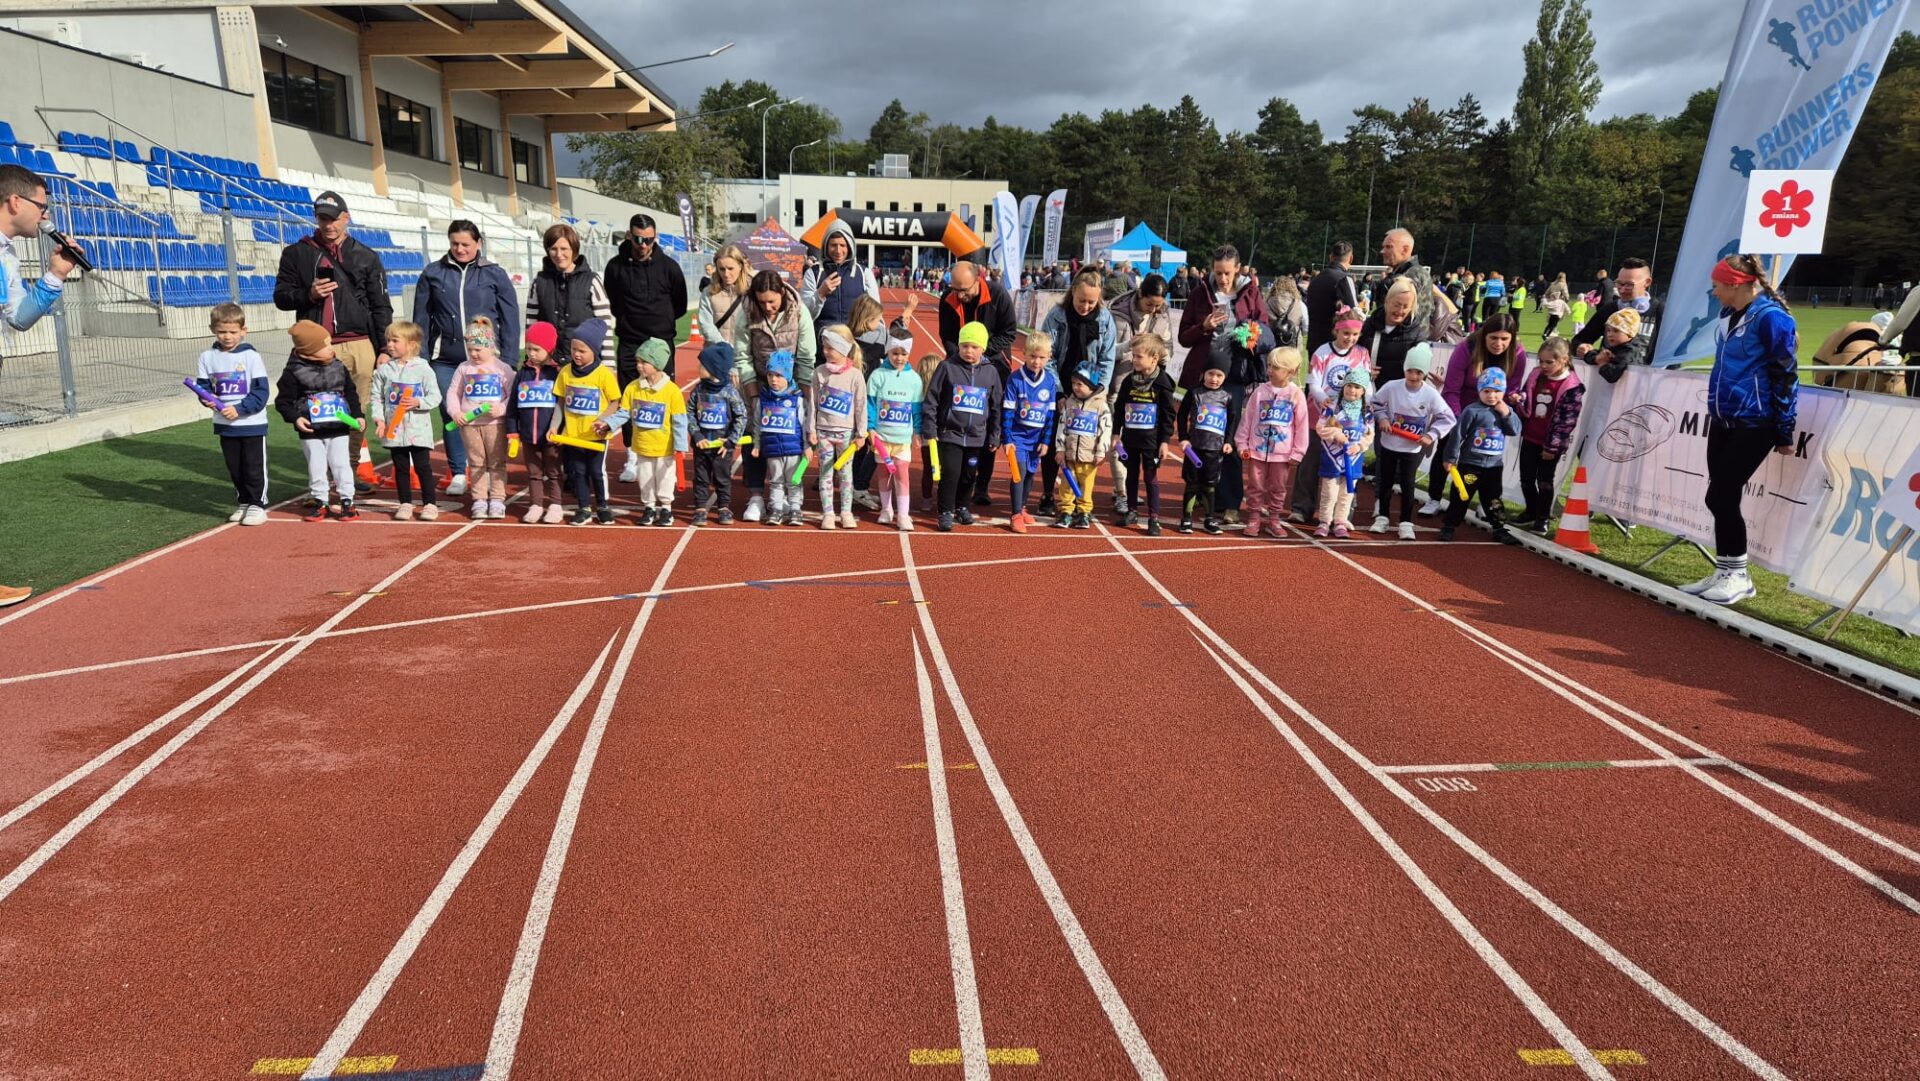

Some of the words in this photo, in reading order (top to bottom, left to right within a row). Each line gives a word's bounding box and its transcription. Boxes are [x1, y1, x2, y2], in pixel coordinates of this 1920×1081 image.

[1796, 0, 1845, 34] RU
[1755, 62, 1875, 160] RUNNER'S
[1781, 195, 1793, 211] 1
[861, 216, 925, 236] META
[220, 382, 240, 394] 1/2
[474, 383, 498, 395] 35/1
[528, 389, 553, 401] 34/1
[962, 395, 983, 408] 40/1
[573, 396, 597, 409] 27/1
[827, 397, 848, 413] 37/1
[638, 411, 661, 424] 28/1
[702, 412, 723, 423] 26/1
[888, 410, 909, 421] 30/1
[1132, 412, 1153, 423] 22/1
[1206, 414, 1224, 428] 31/1
[1267, 409, 1289, 420] 38/1
[771, 416, 793, 428] 23/1
[1073, 418, 1094, 431] 25/1
